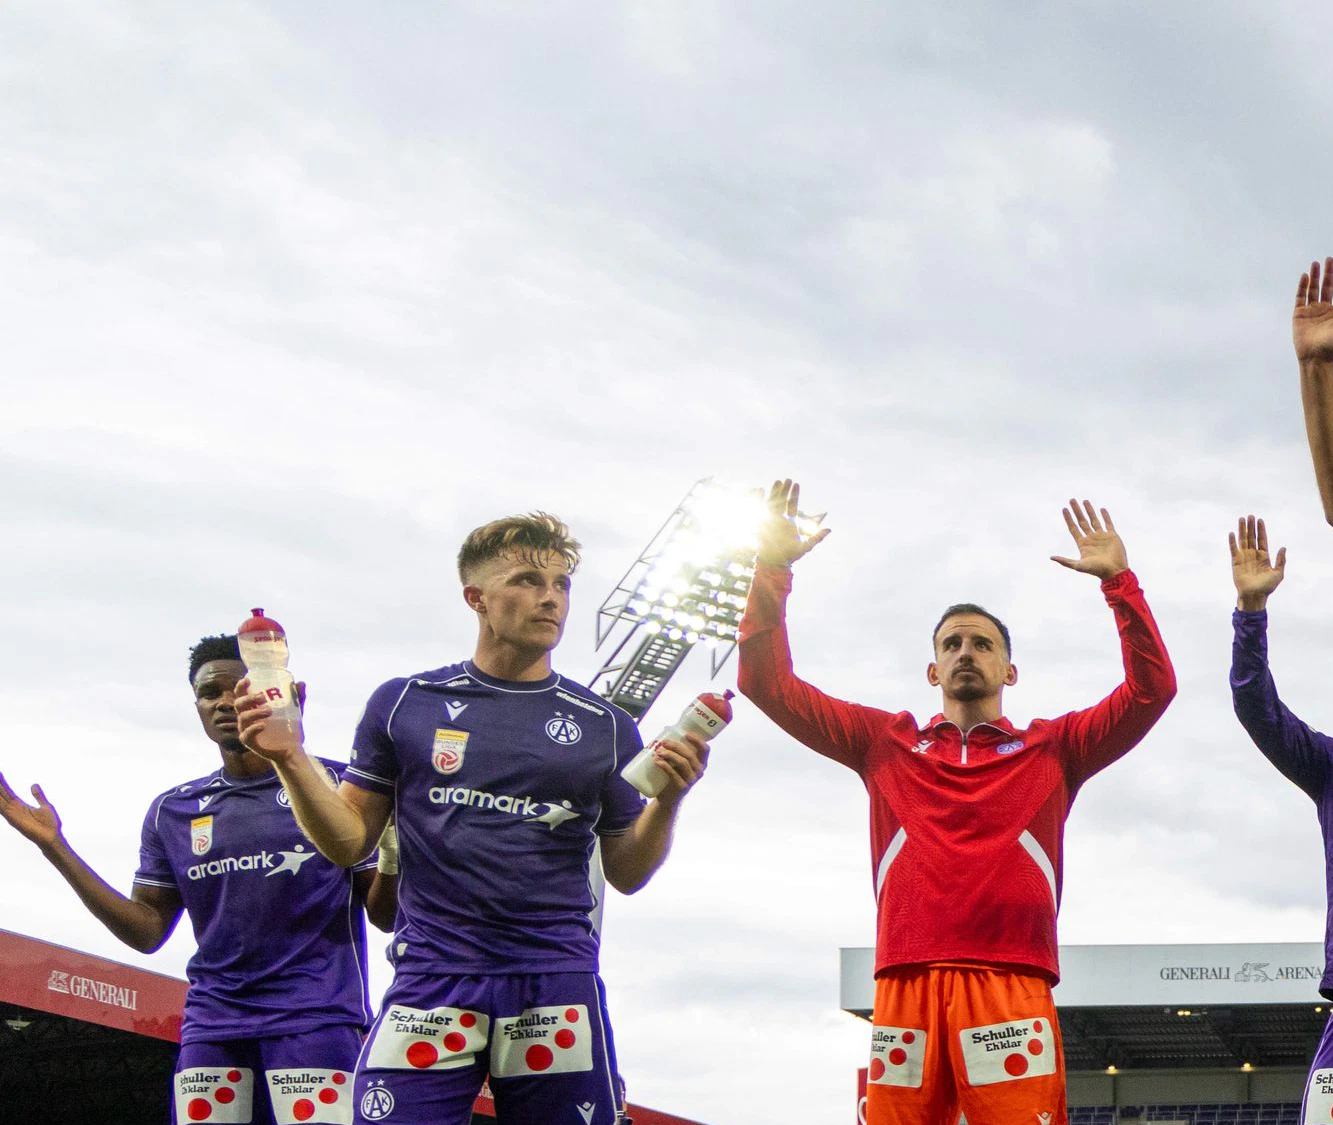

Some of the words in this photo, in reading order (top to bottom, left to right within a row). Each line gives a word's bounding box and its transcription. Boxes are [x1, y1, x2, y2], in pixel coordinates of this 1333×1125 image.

[429, 786, 538, 816] aramark
[187, 850, 274, 881] aramark
[1160, 967, 1231, 981] GENERALI
[1275, 966, 1325, 980] ARENA
[70, 975, 137, 1011] GENERALI
[389, 1010, 453, 1027] Schuller
[971, 1026, 1029, 1044] Schuller
[985, 1040, 1023, 1052] Eh'klar
[272, 1073, 326, 1085] Schuller
[281, 1085, 314, 1095] Eh'klar
